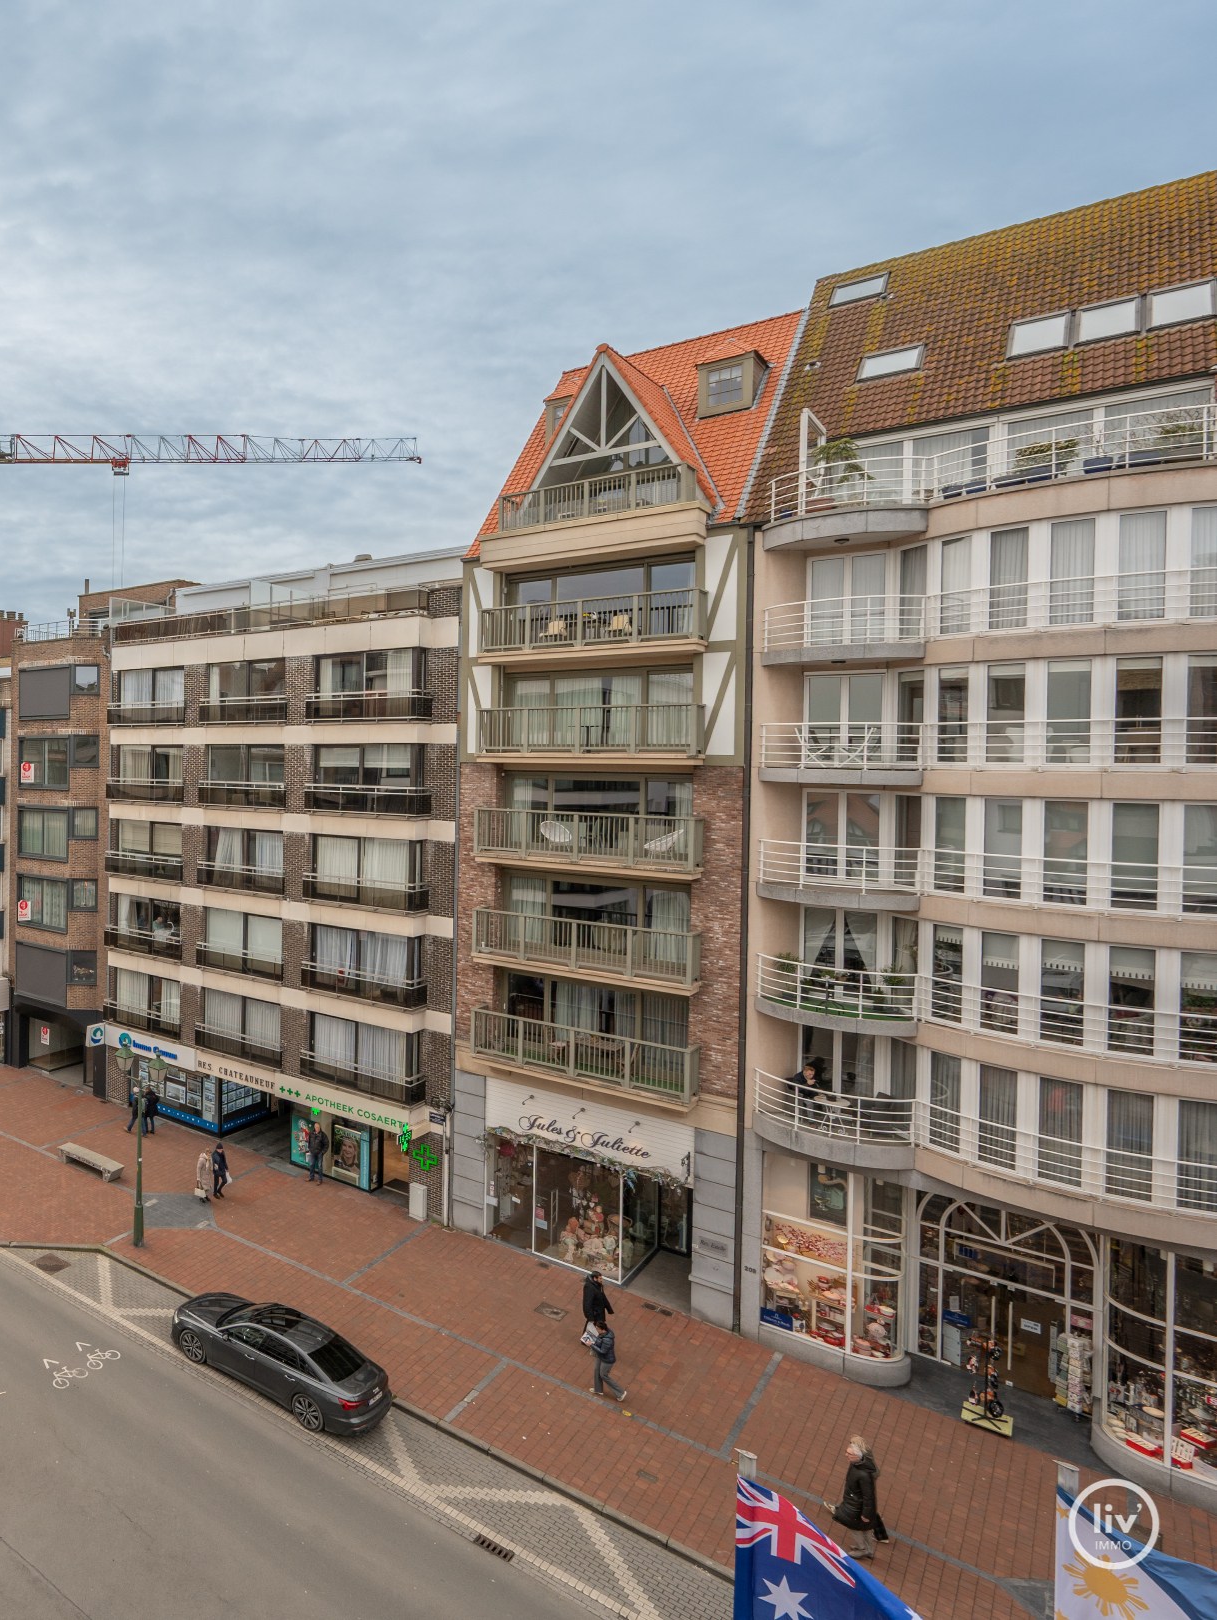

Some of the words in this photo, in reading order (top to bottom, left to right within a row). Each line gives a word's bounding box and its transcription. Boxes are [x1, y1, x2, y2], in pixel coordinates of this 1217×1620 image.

[218, 1066, 275, 1090] CHATEAUNEUF
[304, 1093, 354, 1115] APOTHEEK
[356, 1108, 403, 1129] COSAERT
[519, 1115, 563, 1135] Jules
[564, 1126, 581, 1143] &
[581, 1132, 651, 1158] Juliette
